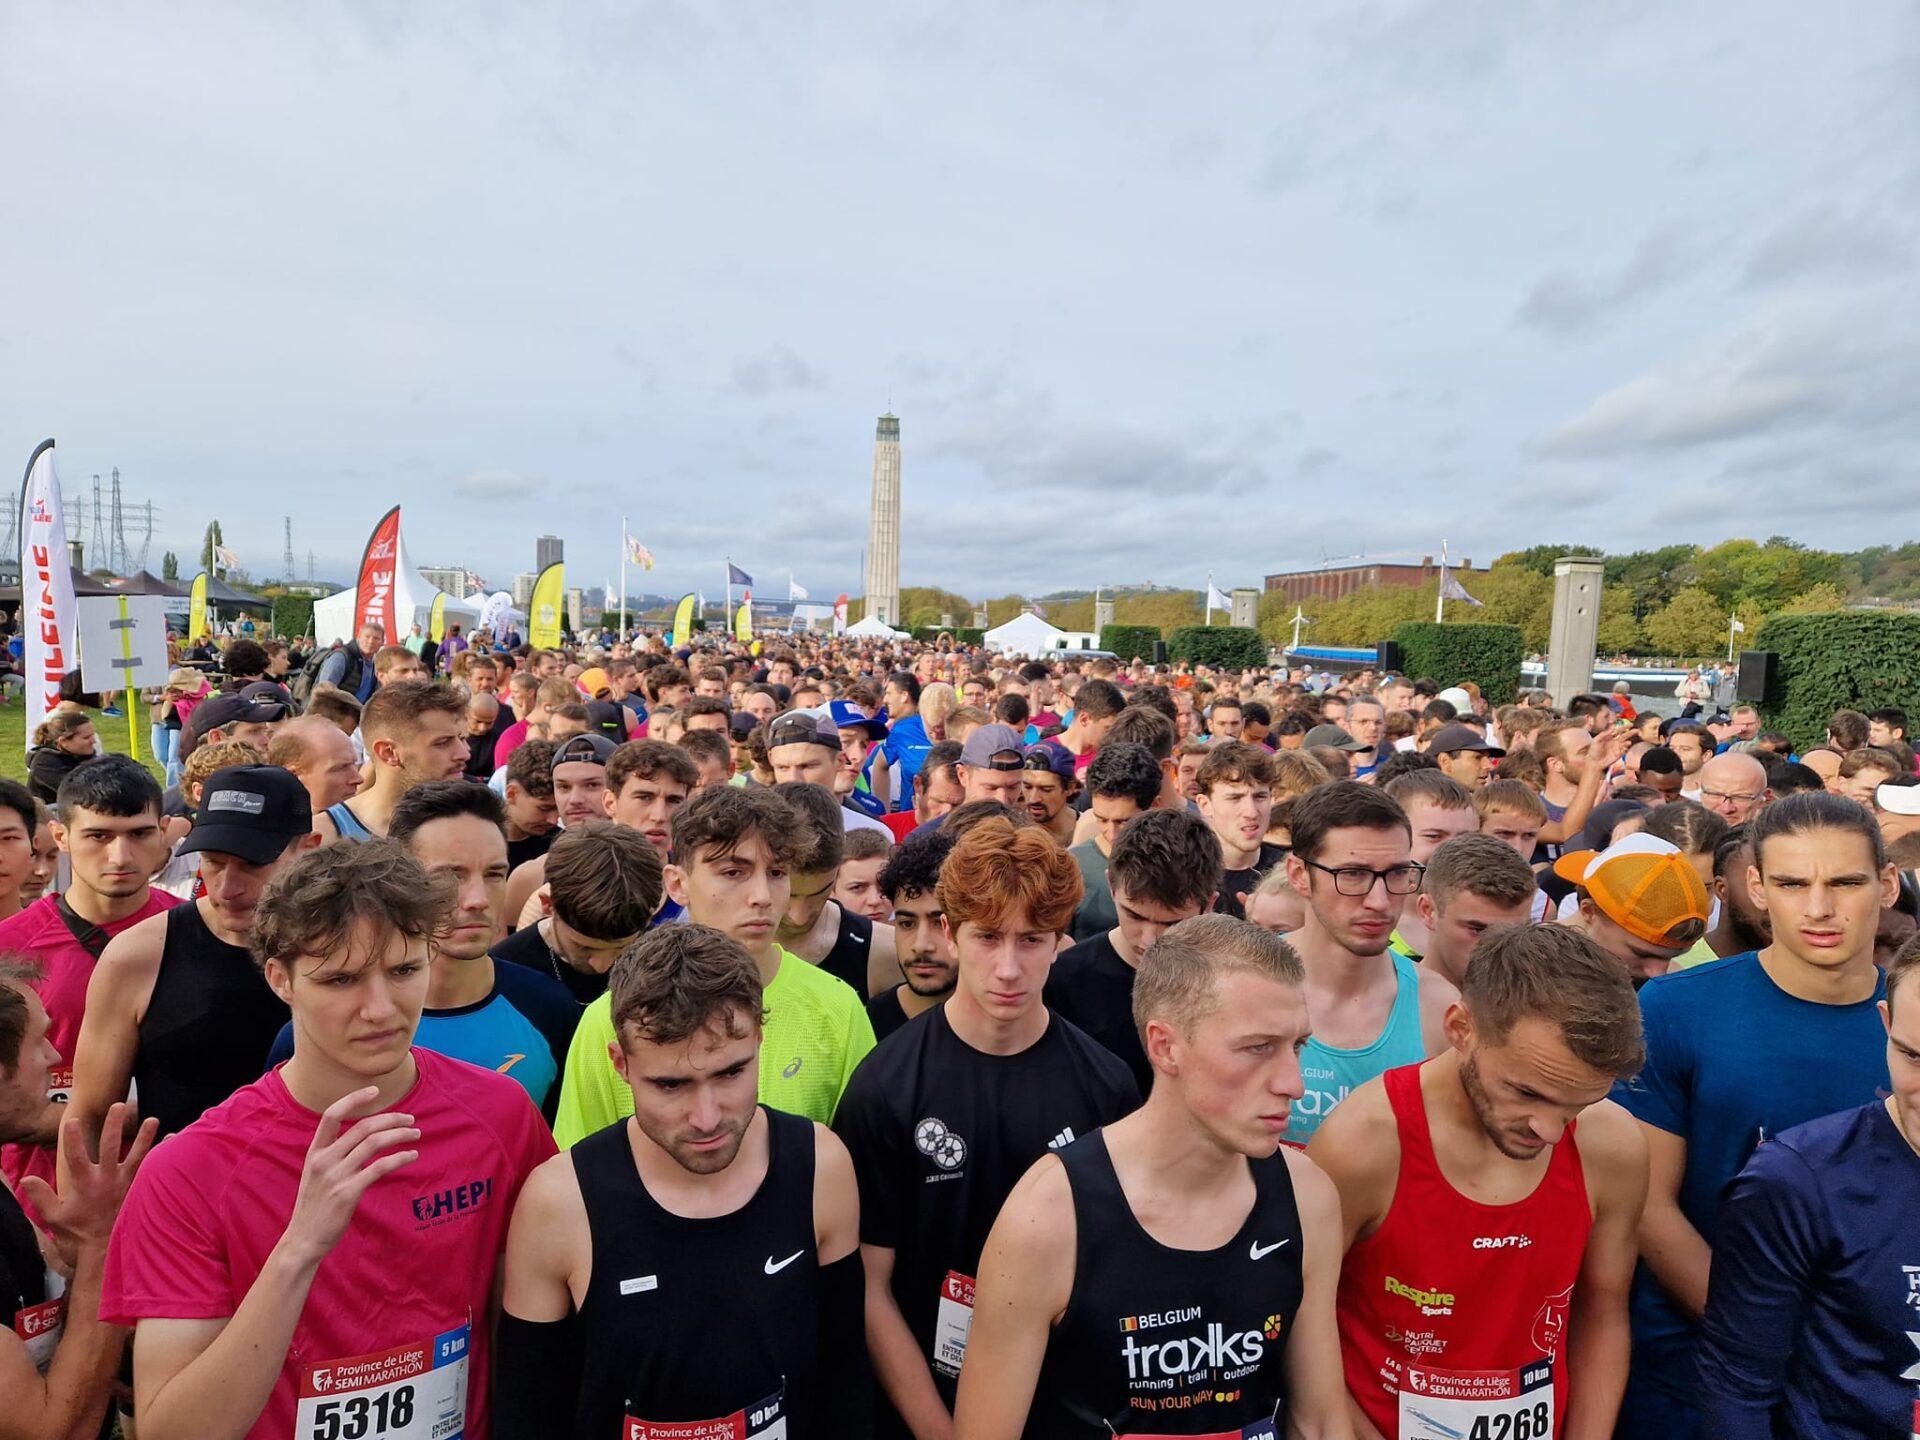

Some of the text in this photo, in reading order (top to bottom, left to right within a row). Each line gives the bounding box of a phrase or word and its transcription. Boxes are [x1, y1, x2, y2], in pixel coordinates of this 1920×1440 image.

[1473, 1236, 1519, 1249] CRAFT
[1384, 1276, 1455, 1307] Respire
[1138, 1306, 1202, 1329] BELGIUM
[1421, 1306, 1452, 1316] Sports
[441, 1337, 465, 1357] 5 km
[1122, 1323, 1264, 1379] trakks
[337, 1350, 424, 1376] Province de Liège
[1129, 1364, 1260, 1390] running trail outdoor
[1430, 1374, 1510, 1388] Province de Liège
[1523, 1367, 1549, 1386] 10 km
[1130, 1390, 1213, 1411] RUN YOUR WAY
[313, 1385, 415, 1440] 5318
[750, 1402, 779, 1427] 10 km
[1468, 1401, 1549, 1440] 4268
[650, 1428, 692, 1437] Province
[694, 1426, 706, 1435] de
